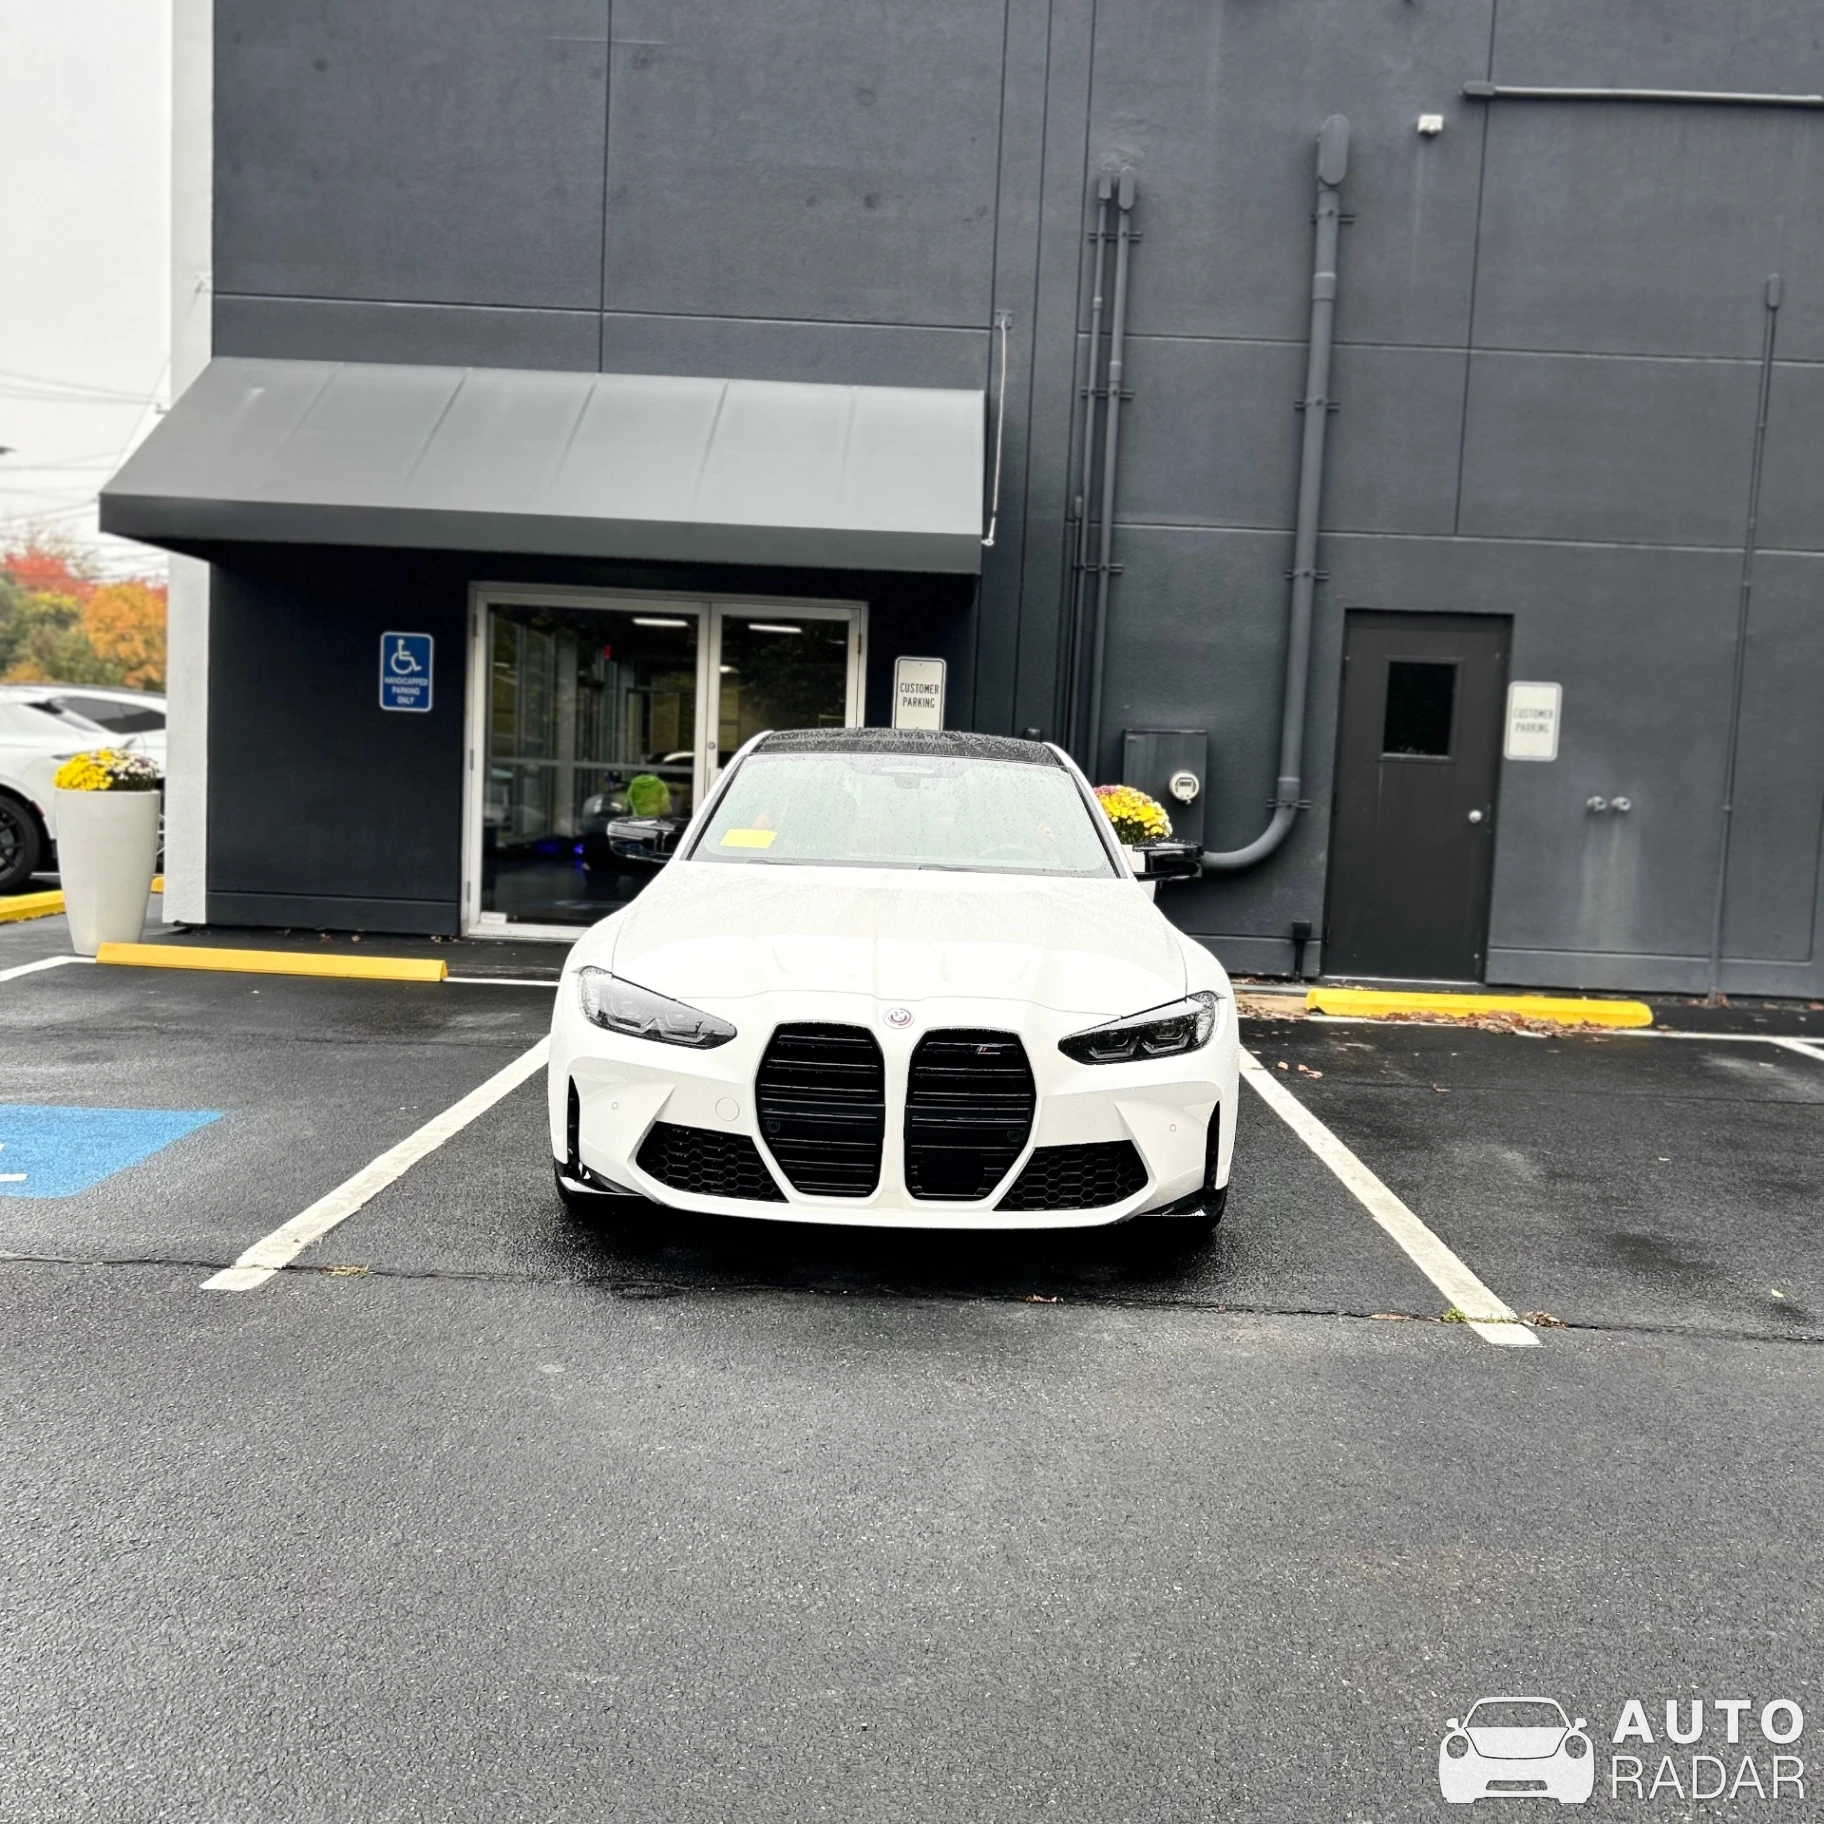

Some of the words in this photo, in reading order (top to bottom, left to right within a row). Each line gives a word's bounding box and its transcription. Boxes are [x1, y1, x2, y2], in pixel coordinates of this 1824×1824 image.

[384, 677, 428, 686] HANDICAPPED
[392, 686, 420, 695] PARKING
[900, 683, 939, 694] CUSTOMER
[397, 696, 415, 704] ONLY
[902, 697, 935, 708] PARKING
[1514, 722, 1549, 733] PARKING
